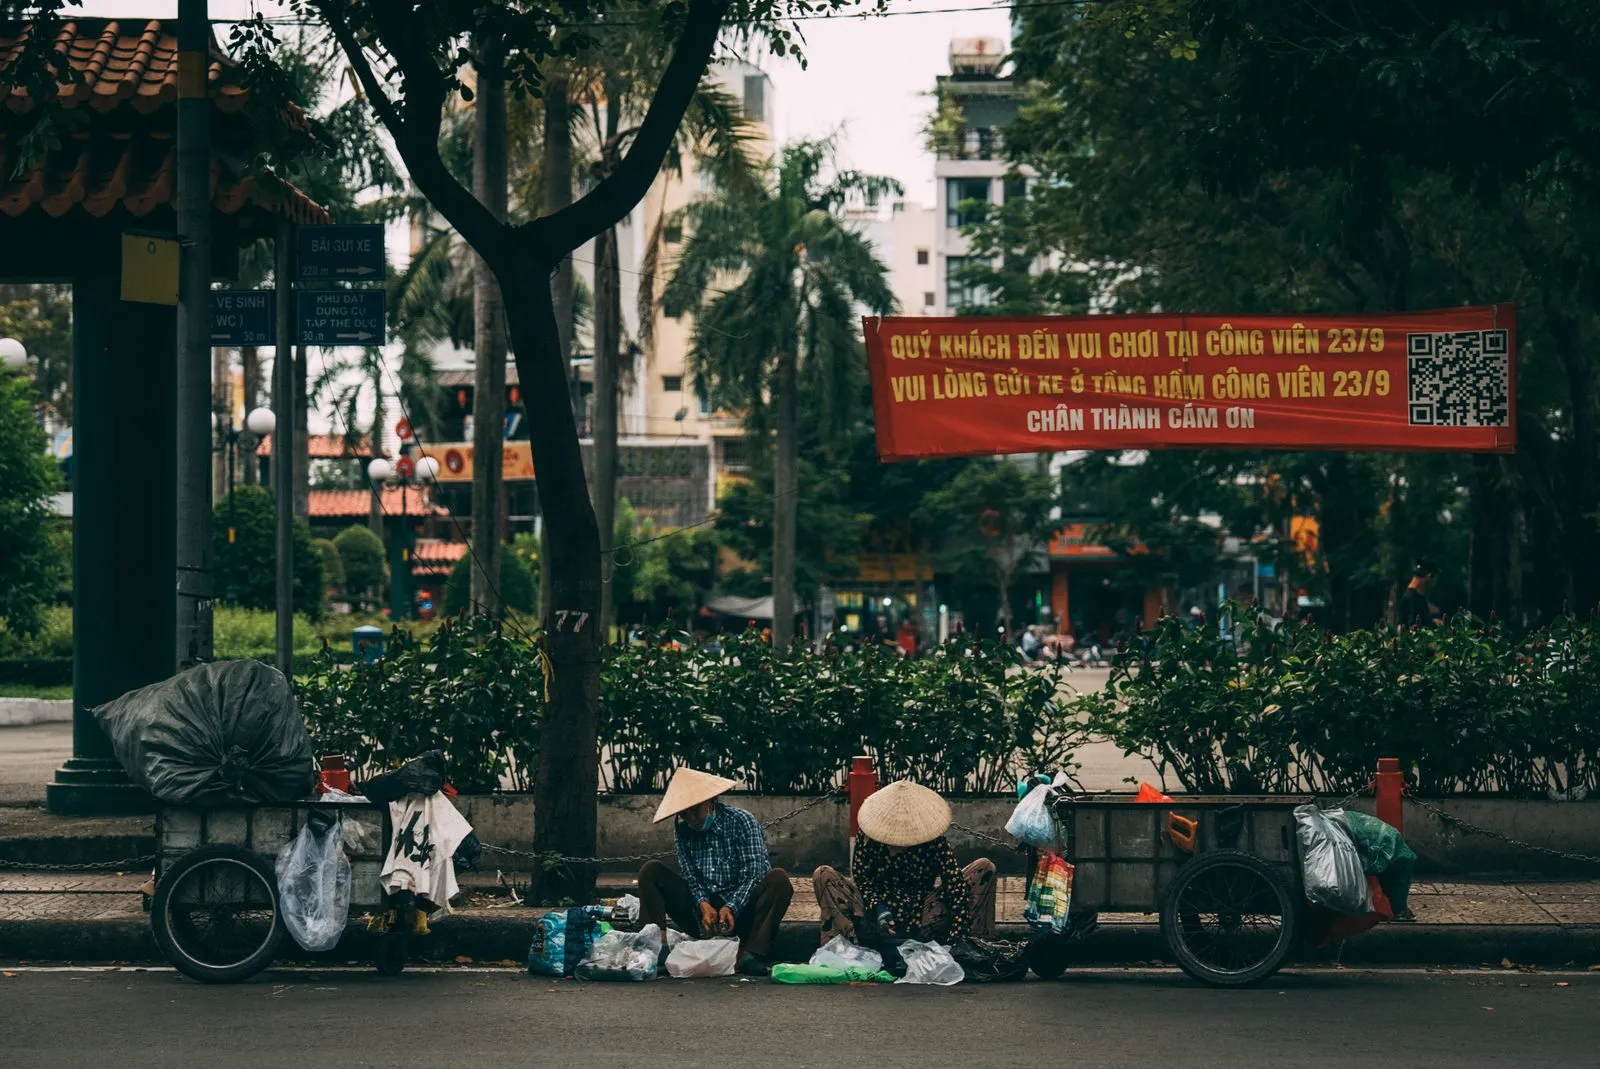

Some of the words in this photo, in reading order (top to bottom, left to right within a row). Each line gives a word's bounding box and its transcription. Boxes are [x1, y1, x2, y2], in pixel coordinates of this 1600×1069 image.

[356, 239, 371, 252] XE
[320, 267, 329, 276] m
[236, 296, 265, 308] SINH
[316, 295, 340, 304] KHU
[243, 330, 254, 341] 30
[256, 332, 265, 340] m
[303, 330, 313, 341] 30
[890, 329, 931, 360] QUÝ
[939, 328, 1012, 360] KHÁCH
[1018, 327, 1060, 360] ĐẾN
[1065, 332, 1102, 359] VUI
[1108, 328, 1159, 358] CHƠI
[1165, 330, 1199, 362] TẠI
[1206, 323, 1266, 356] CÔNG
[1270, 322, 1320, 354] VIÊN
[1327, 327, 1385, 353] 23/9
[890, 374, 926, 402] VUI
[933, 367, 988, 400] LÒNG
[993, 367, 1031, 396] GỬI
[1037, 374, 1064, 394] XE
[1070, 366, 1085, 394] Ở
[1091, 368, 1147, 395] TẦNG
[1153, 368, 1205, 400] HẦM
[1212, 366, 1271, 400] CÔNG
[1276, 364, 1325, 398] VIÊN
[1332, 369, 1390, 397] 23/9
[1027, 403, 1084, 432] CHÂN
[1091, 403, 1161, 430] THÀNH
[1168, 402, 1218, 429] CÁM
[1225, 406, 1255, 429] ƠN
[555, 609, 589, 632] 77
